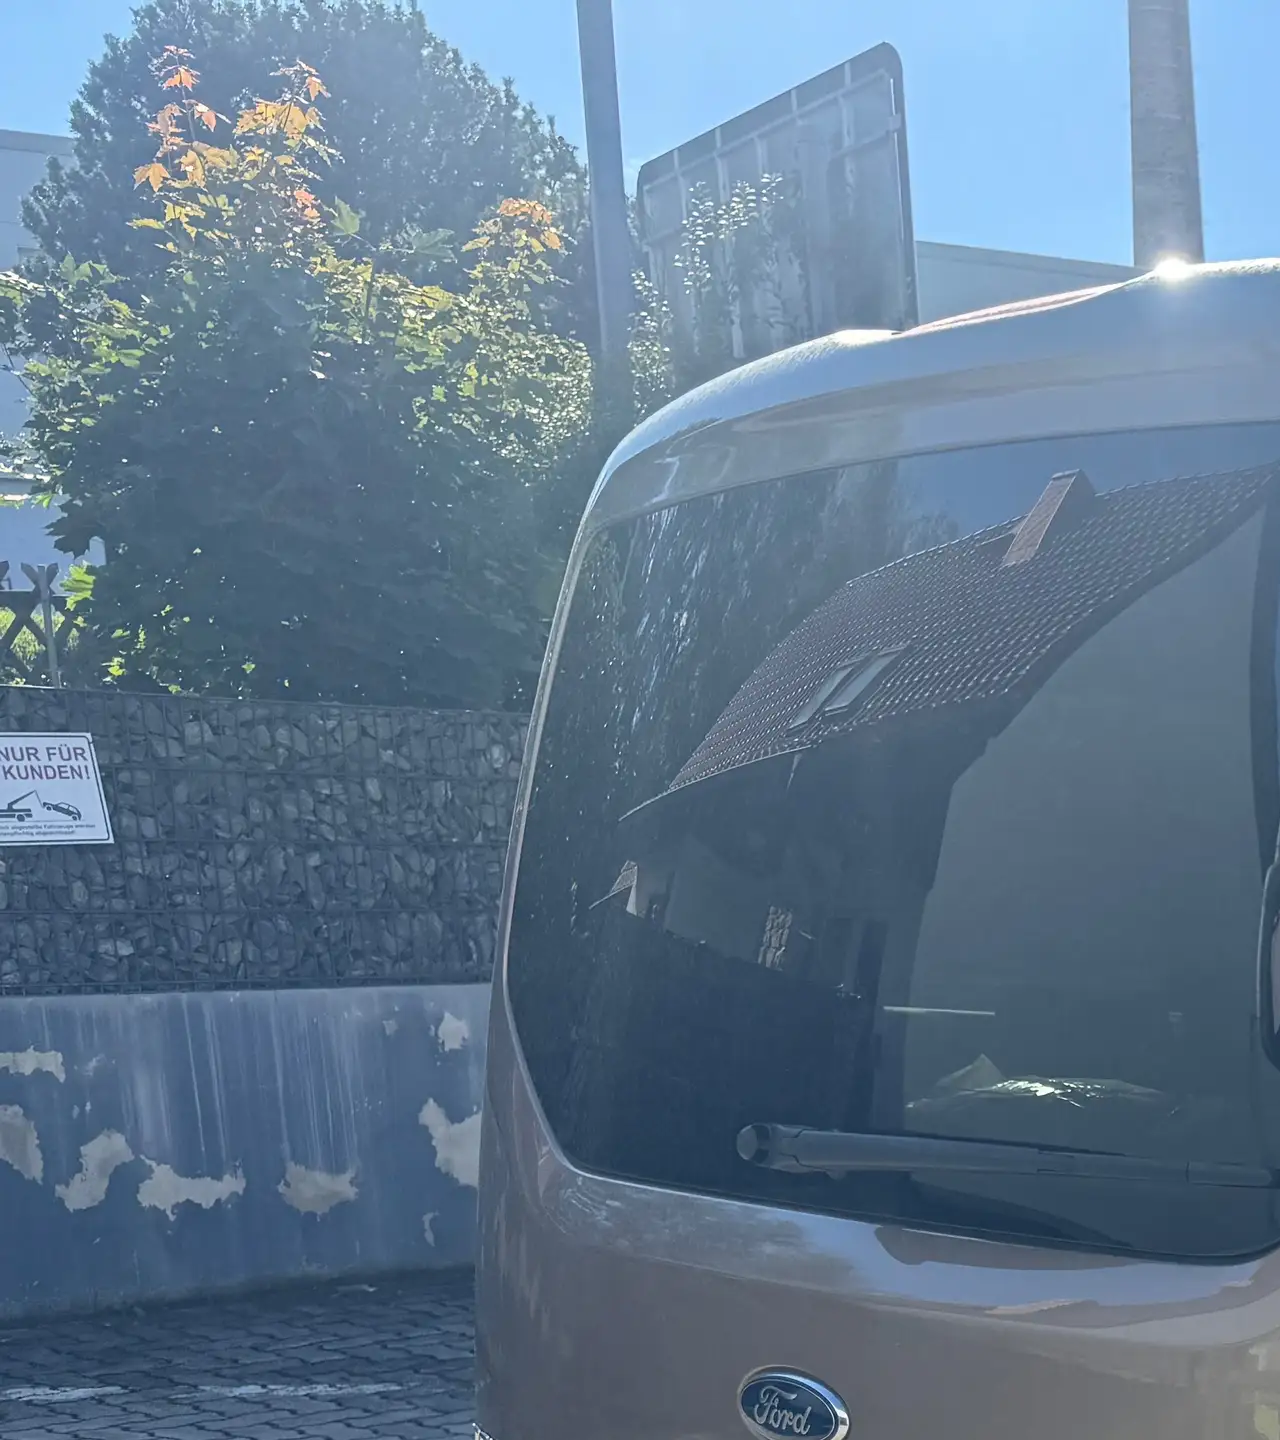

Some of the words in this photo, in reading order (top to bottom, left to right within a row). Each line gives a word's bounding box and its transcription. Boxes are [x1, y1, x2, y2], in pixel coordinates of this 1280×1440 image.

[0, 747, 41, 761] NUR
[46, 744, 88, 761] FÜR
[2, 765, 90, 780] KUNDEN!
[754, 1386, 812, 1435] Ford
